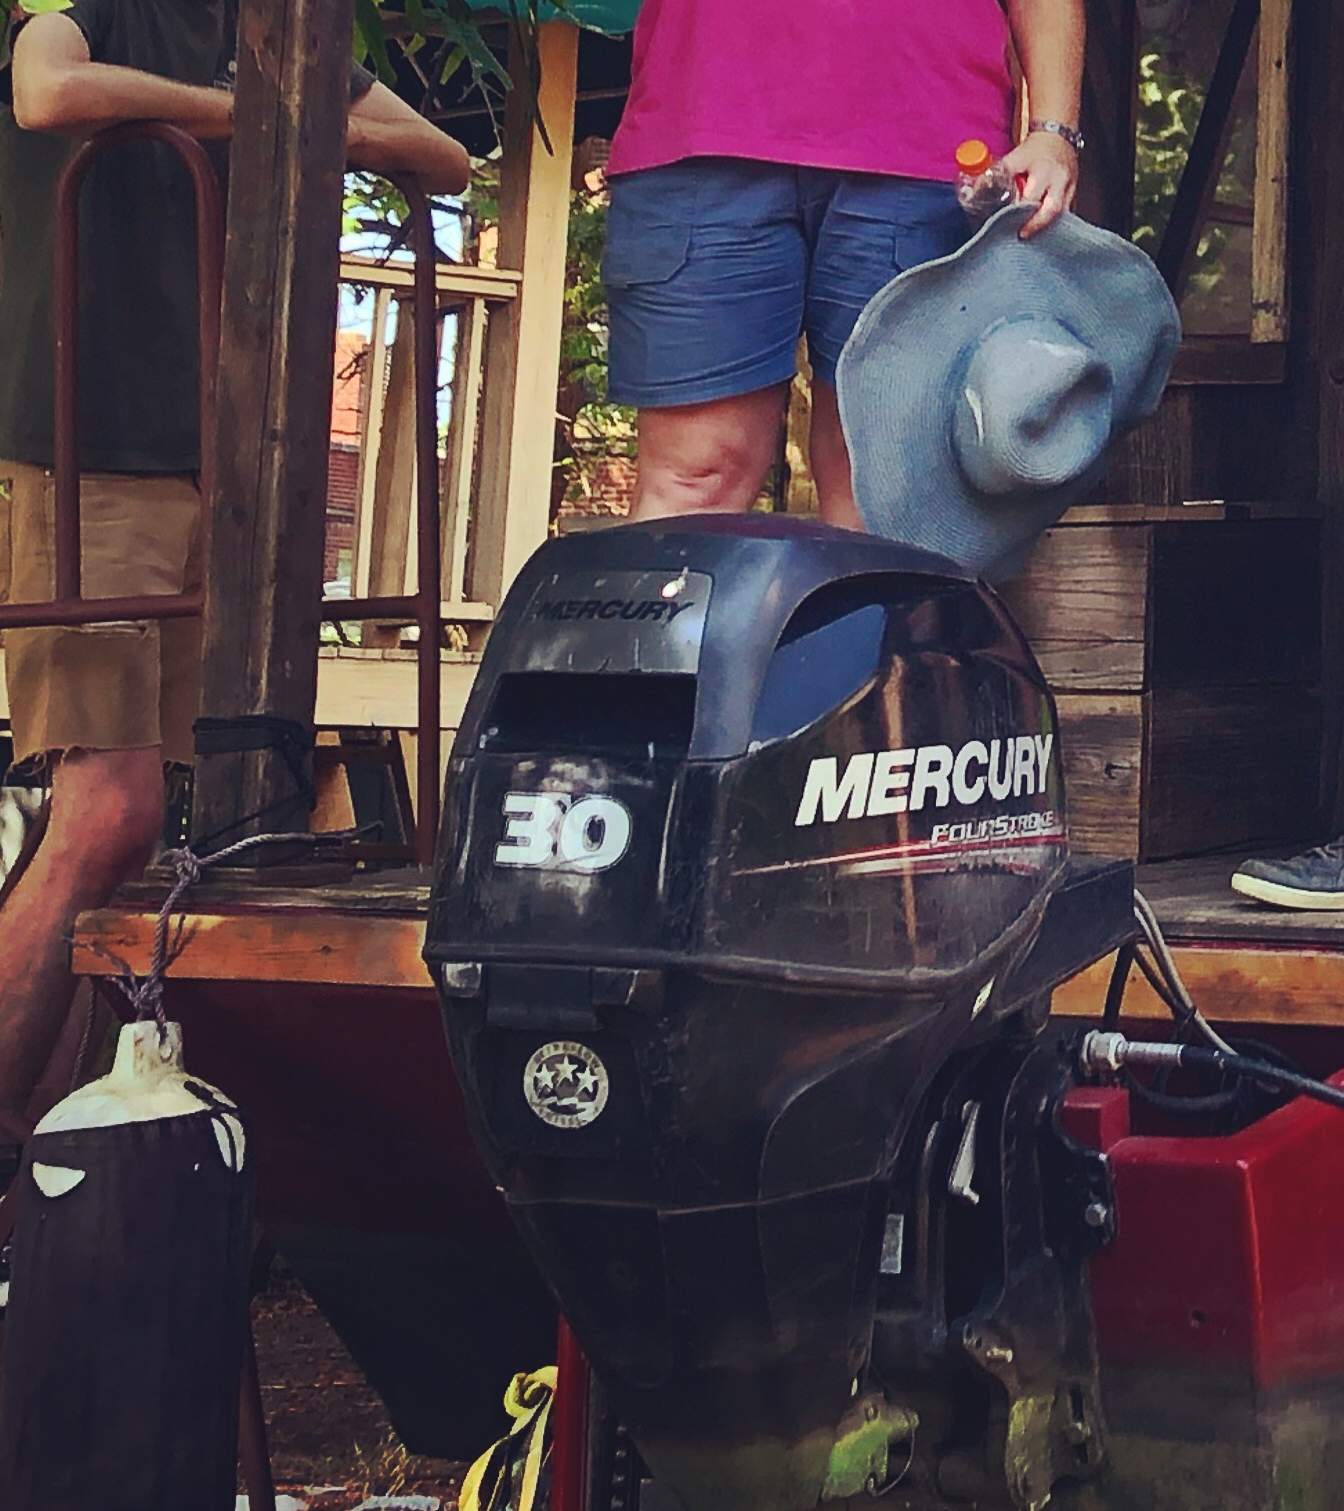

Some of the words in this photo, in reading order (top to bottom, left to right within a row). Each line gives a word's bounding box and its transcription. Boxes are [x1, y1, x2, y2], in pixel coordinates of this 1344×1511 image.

[538, 599, 694, 623] MERCURY
[795, 733, 1053, 827] MERCURY
[495, 792, 632, 873] 30
